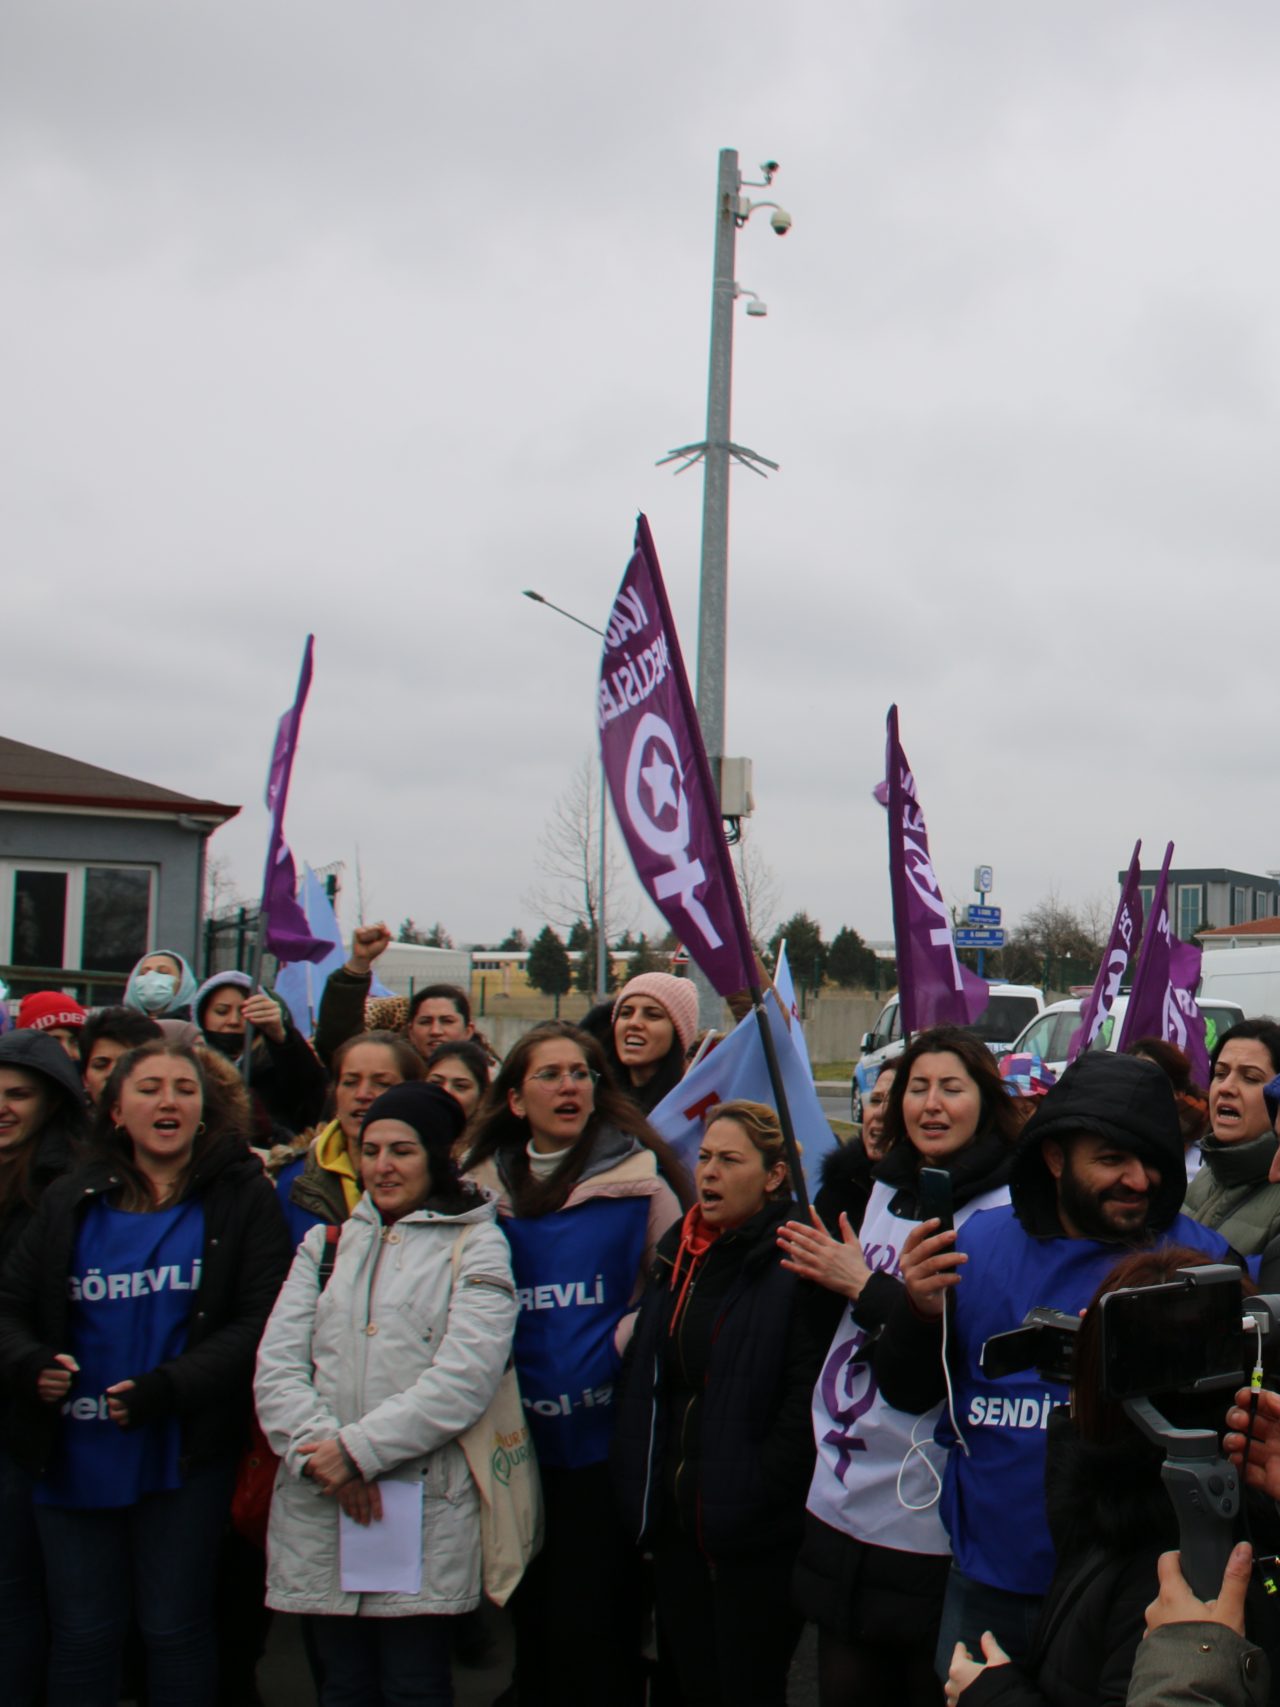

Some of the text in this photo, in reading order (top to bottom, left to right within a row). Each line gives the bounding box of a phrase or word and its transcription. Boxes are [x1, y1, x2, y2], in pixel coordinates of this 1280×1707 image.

[67, 1259, 202, 1300] GÖREVLİ
[514, 1274, 604, 1312] REVLİ
[523, 1385, 613, 1416] ol-iş
[968, 1393, 1071, 1429] SENDİ
